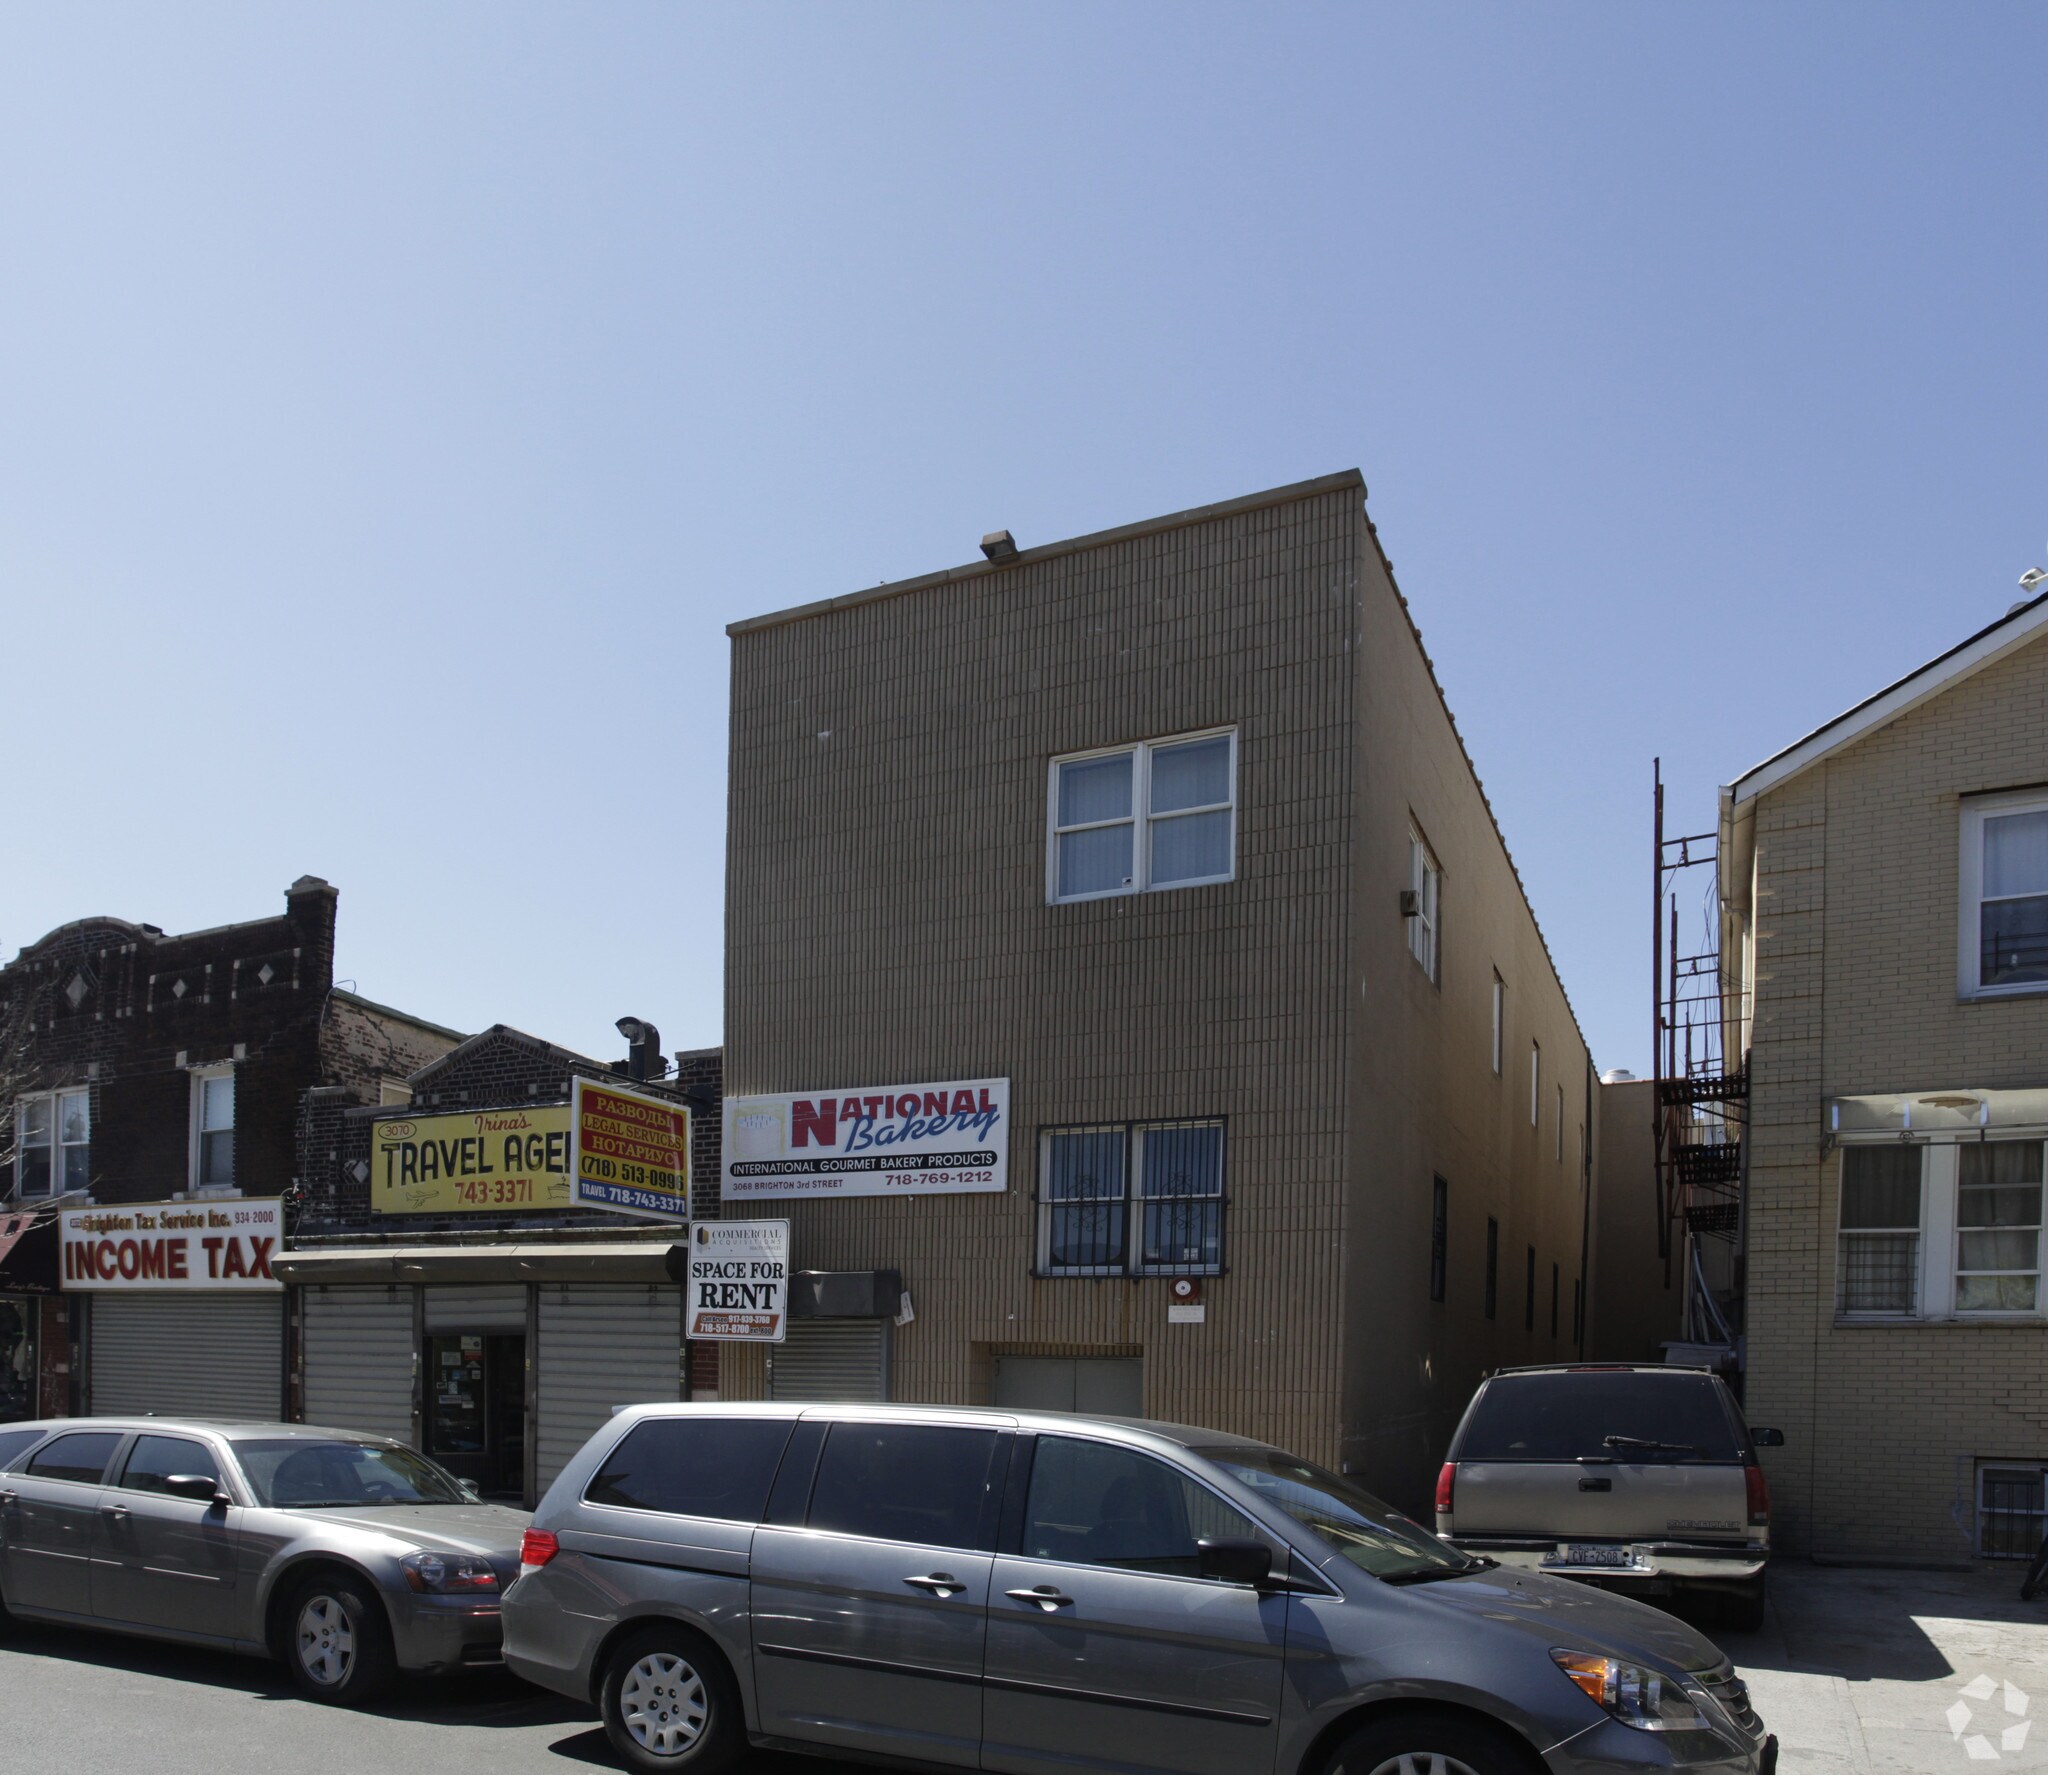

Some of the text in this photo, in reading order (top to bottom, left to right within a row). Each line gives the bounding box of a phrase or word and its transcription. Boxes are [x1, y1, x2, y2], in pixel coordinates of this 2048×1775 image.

[596, 1096, 672, 1127] РАЗВОДЫ
[791, 1088, 998, 1148] NATIONAL
[385, 1125, 410, 1137] 3070
[584, 1114, 682, 1149] LEGAL SERVICES
[845, 1103, 1000, 1153] Bakery
[381, 1131, 571, 1189] TRAVEL AGE
[592, 1135, 675, 1165] НОТАРИУС
[733, 1153, 993, 1175] INTERNATIONAL GOURMET BAKERY PRODUCTS
[581, 1155, 684, 1191] (718) 513-0996
[755, 1181, 794, 1190] BRIGHTON
[796, 1180, 810, 1189] 3rd
[812, 1179, 843, 1189] STREET
[885, 1171, 993, 1186] 718-769-1212
[454, 1179, 533, 1205] 743-3371
[582, 1182, 686, 1213] TRAVEL 718-743-3371
[135, 1212, 157, 1230] Tax
[160, 1210, 204, 1230] Service
[208, 1208, 232, 1227] Inc.
[234, 1211, 274, 1225] 934-2000
[712, 1229, 782, 1239] COMMERCIAL
[65, 1236, 276, 1280] INCOME TAX
[692, 1262, 784, 1279] SPACE FOR
[698, 1283, 777, 1310] RENT
